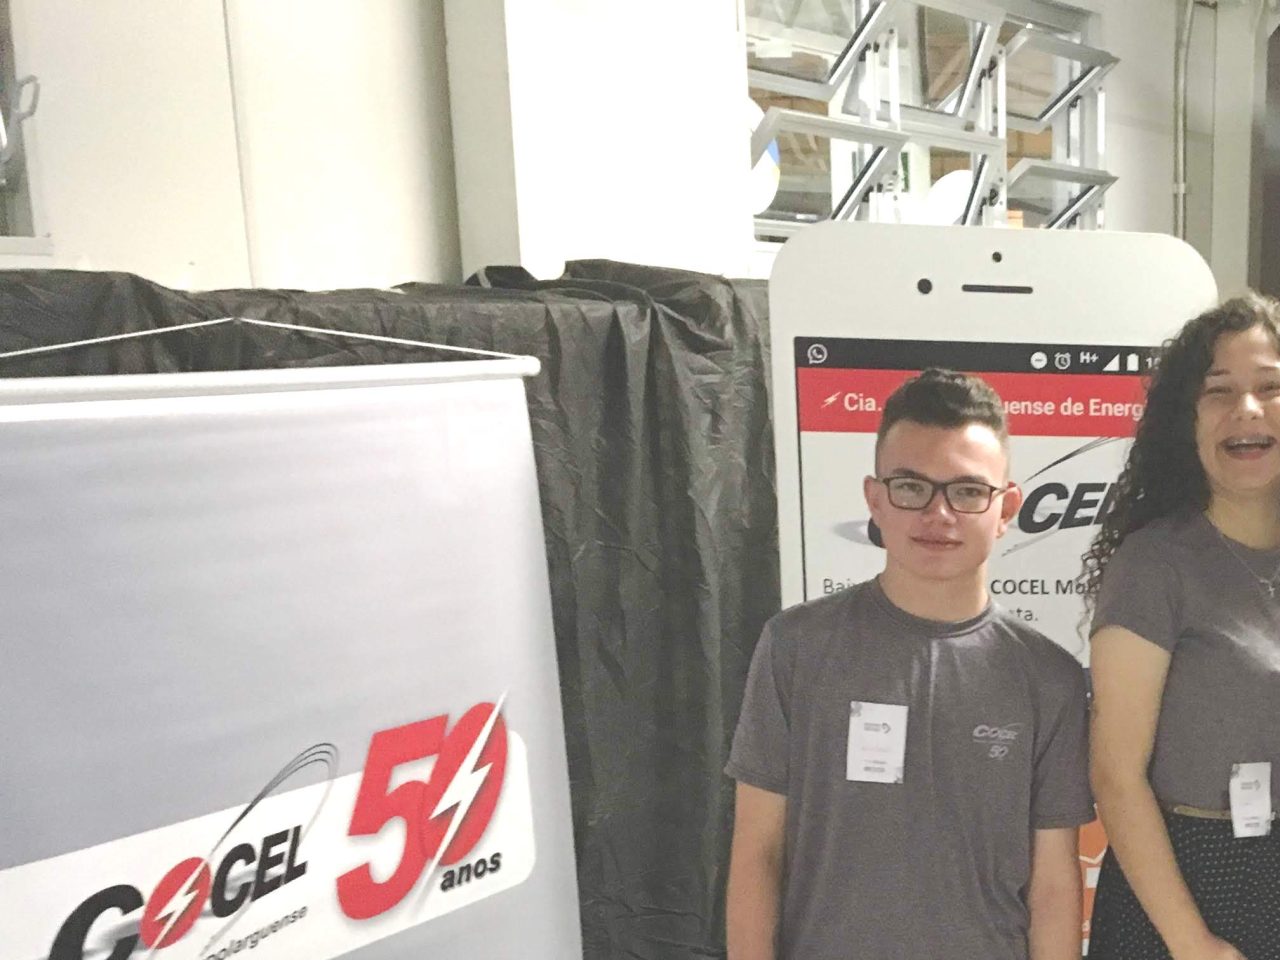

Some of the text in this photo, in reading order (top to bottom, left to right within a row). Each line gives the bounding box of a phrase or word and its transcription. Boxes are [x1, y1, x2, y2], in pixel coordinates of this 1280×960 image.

[843, 392, 883, 412] Cia.
[1060, 397, 1084, 416] de
[990, 579, 1050, 596] COCEL
[335, 700, 509, 921] 50
[440, 850, 504, 894] anos
